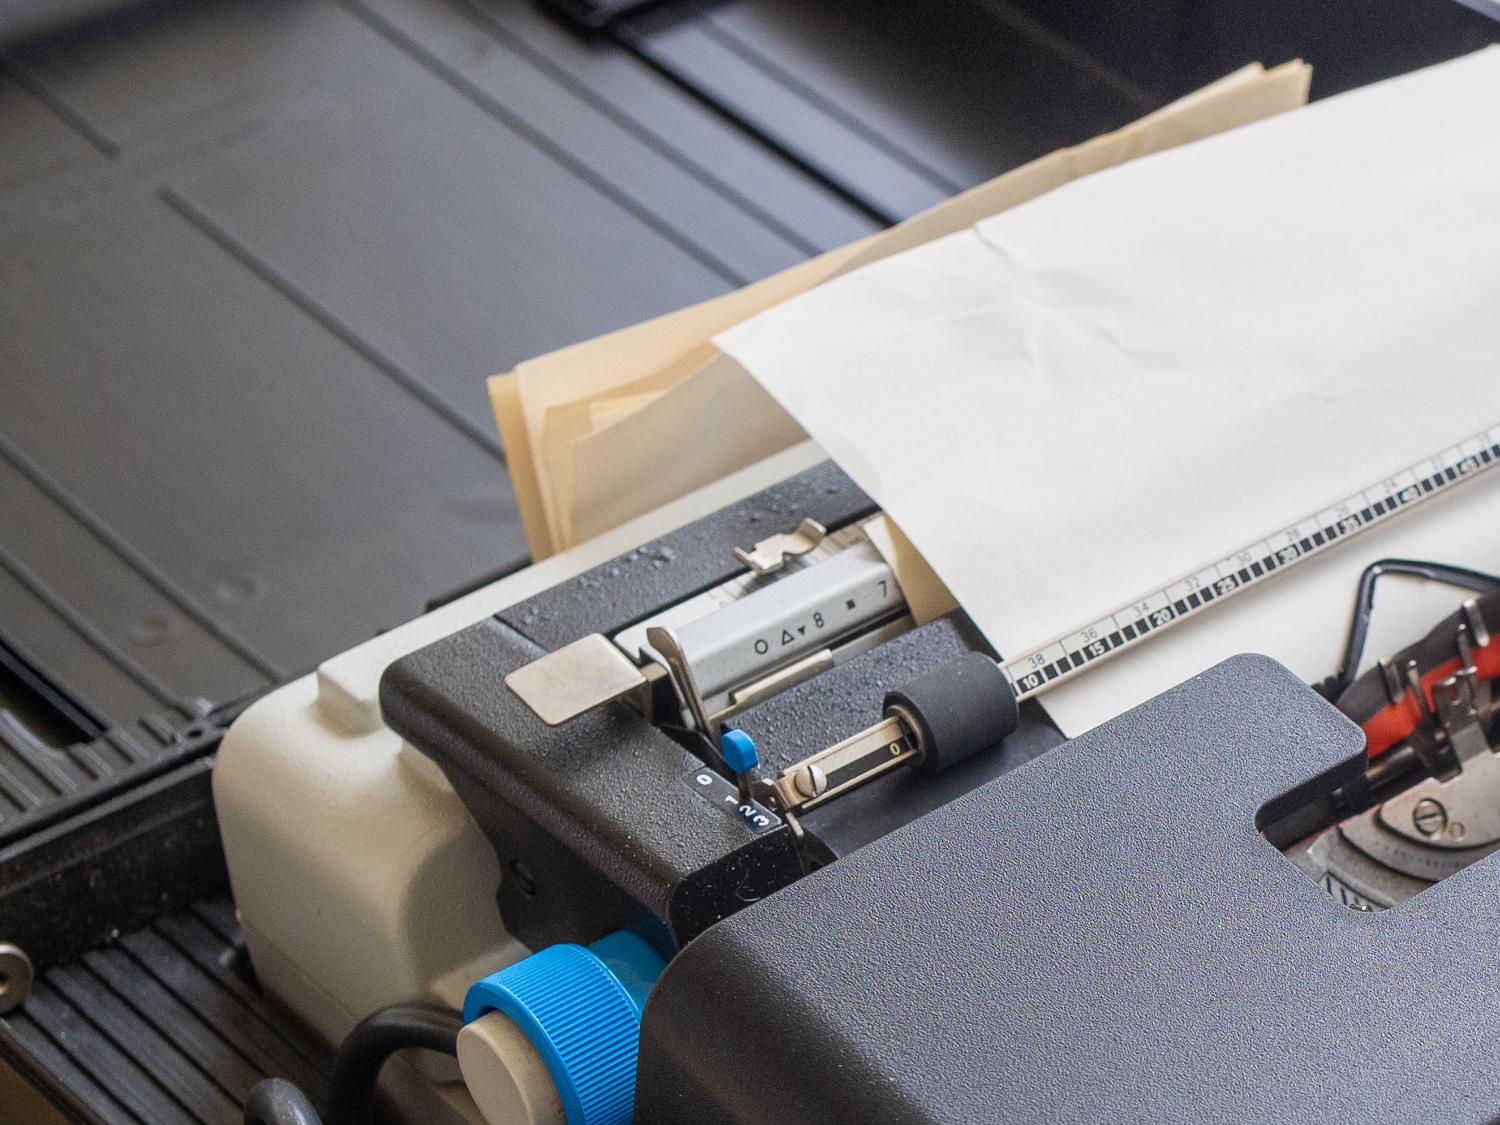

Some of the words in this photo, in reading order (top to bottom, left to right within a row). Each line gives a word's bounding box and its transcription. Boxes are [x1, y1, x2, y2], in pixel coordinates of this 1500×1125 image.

[1022, 674, 1039, 689] 10
[1088, 642, 1105, 656] 15
[1152, 609, 1172, 626] 20
[1028, 653, 1046, 670] 38
[1080, 627, 1099, 643] 36
[1134, 602, 1149, 617] 34
[696, 774, 712, 785] 0
[739, 805, 756, 817] 2
[753, 815, 770, 827] 3
